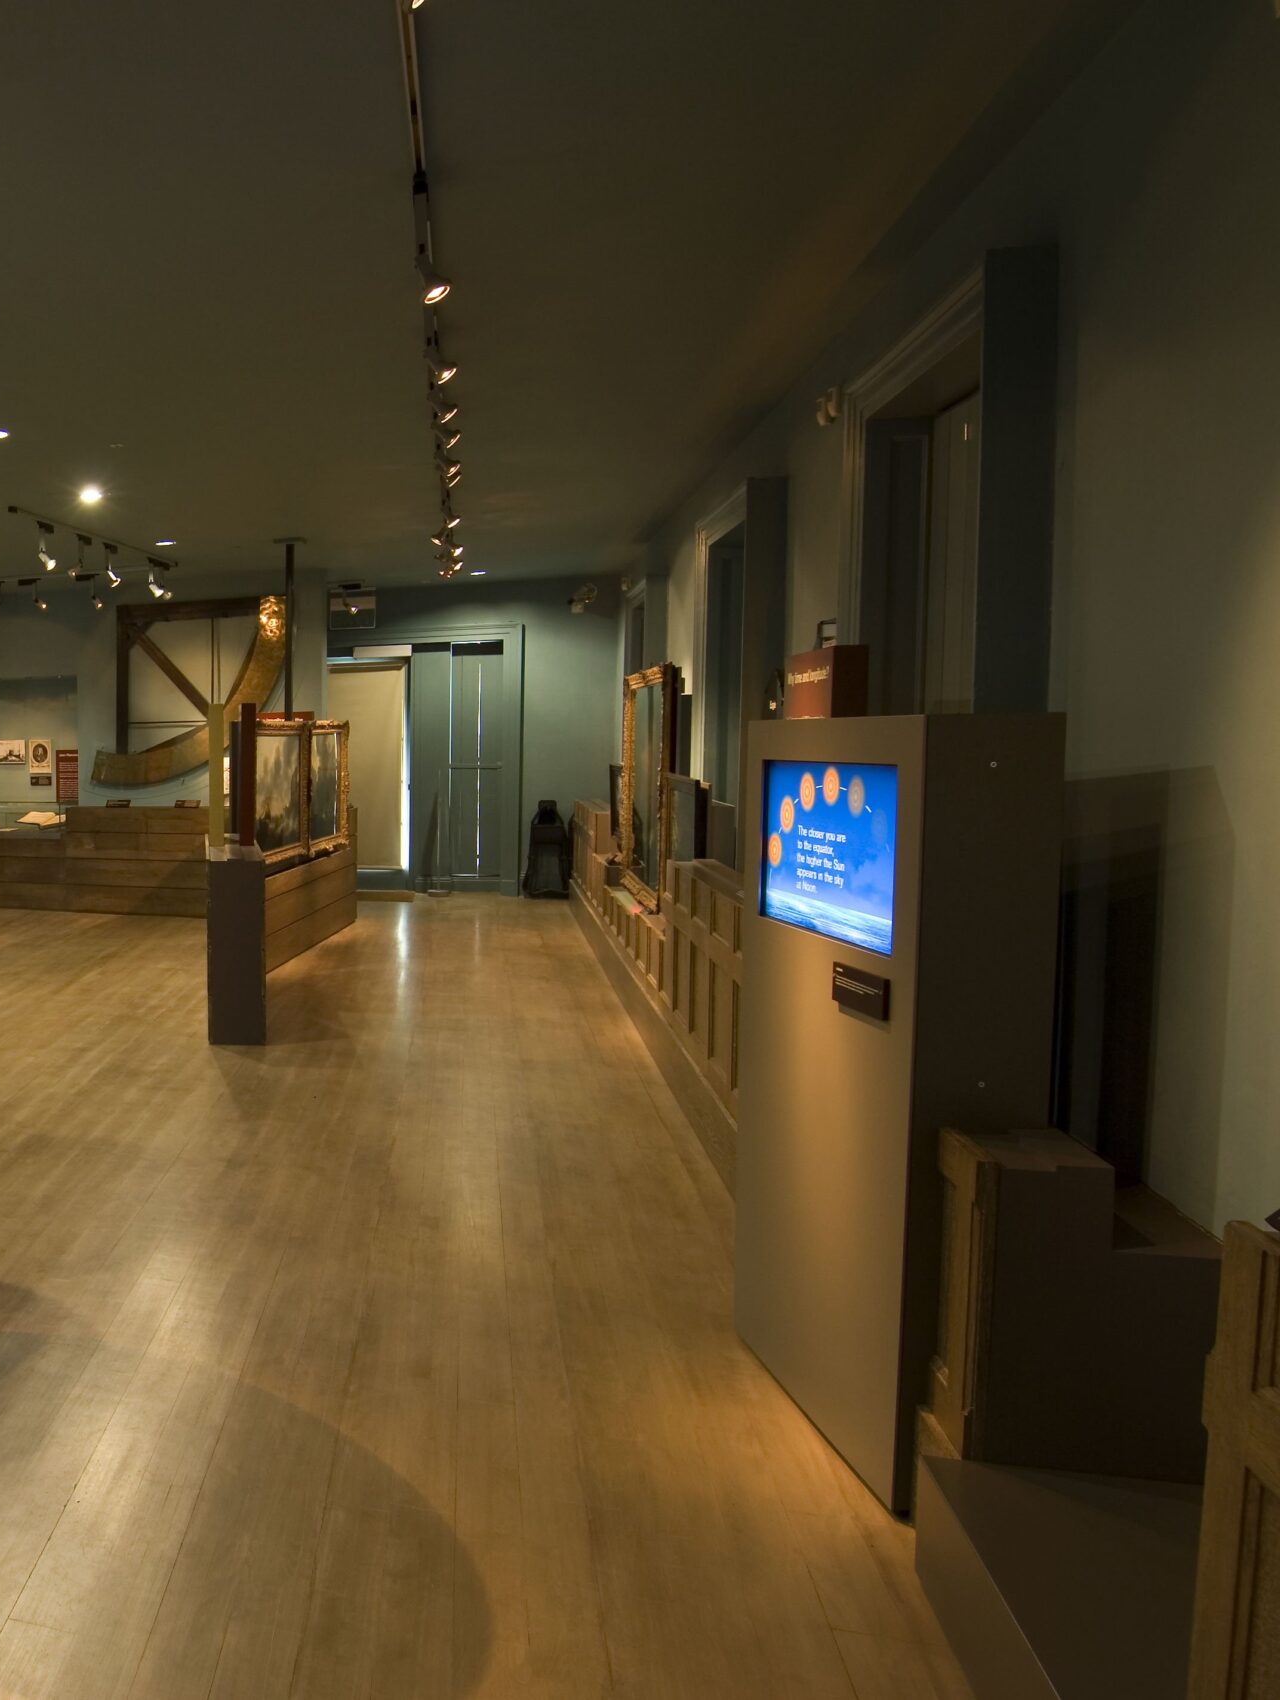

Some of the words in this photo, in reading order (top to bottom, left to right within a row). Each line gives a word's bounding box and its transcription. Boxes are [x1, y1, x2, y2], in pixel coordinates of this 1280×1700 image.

[797, 824, 808, 837] The
[808, 827, 825, 839] closer
[825, 832, 836, 843] you
[836, 833, 847, 843] are
[797, 840, 803, 849] to
[803, 840, 812, 851] the
[812, 844, 834, 857] equator,
[796, 852, 805, 863] the
[805, 854, 822, 868] higher
[823, 857, 833, 869] the
[833, 858, 845, 872] Sun
[795, 881, 802, 890] at
[796, 868, 817, 880] appears
[817, 872, 823, 881] in
[824, 871, 833, 883] the
[833, 874, 844, 889] sky
